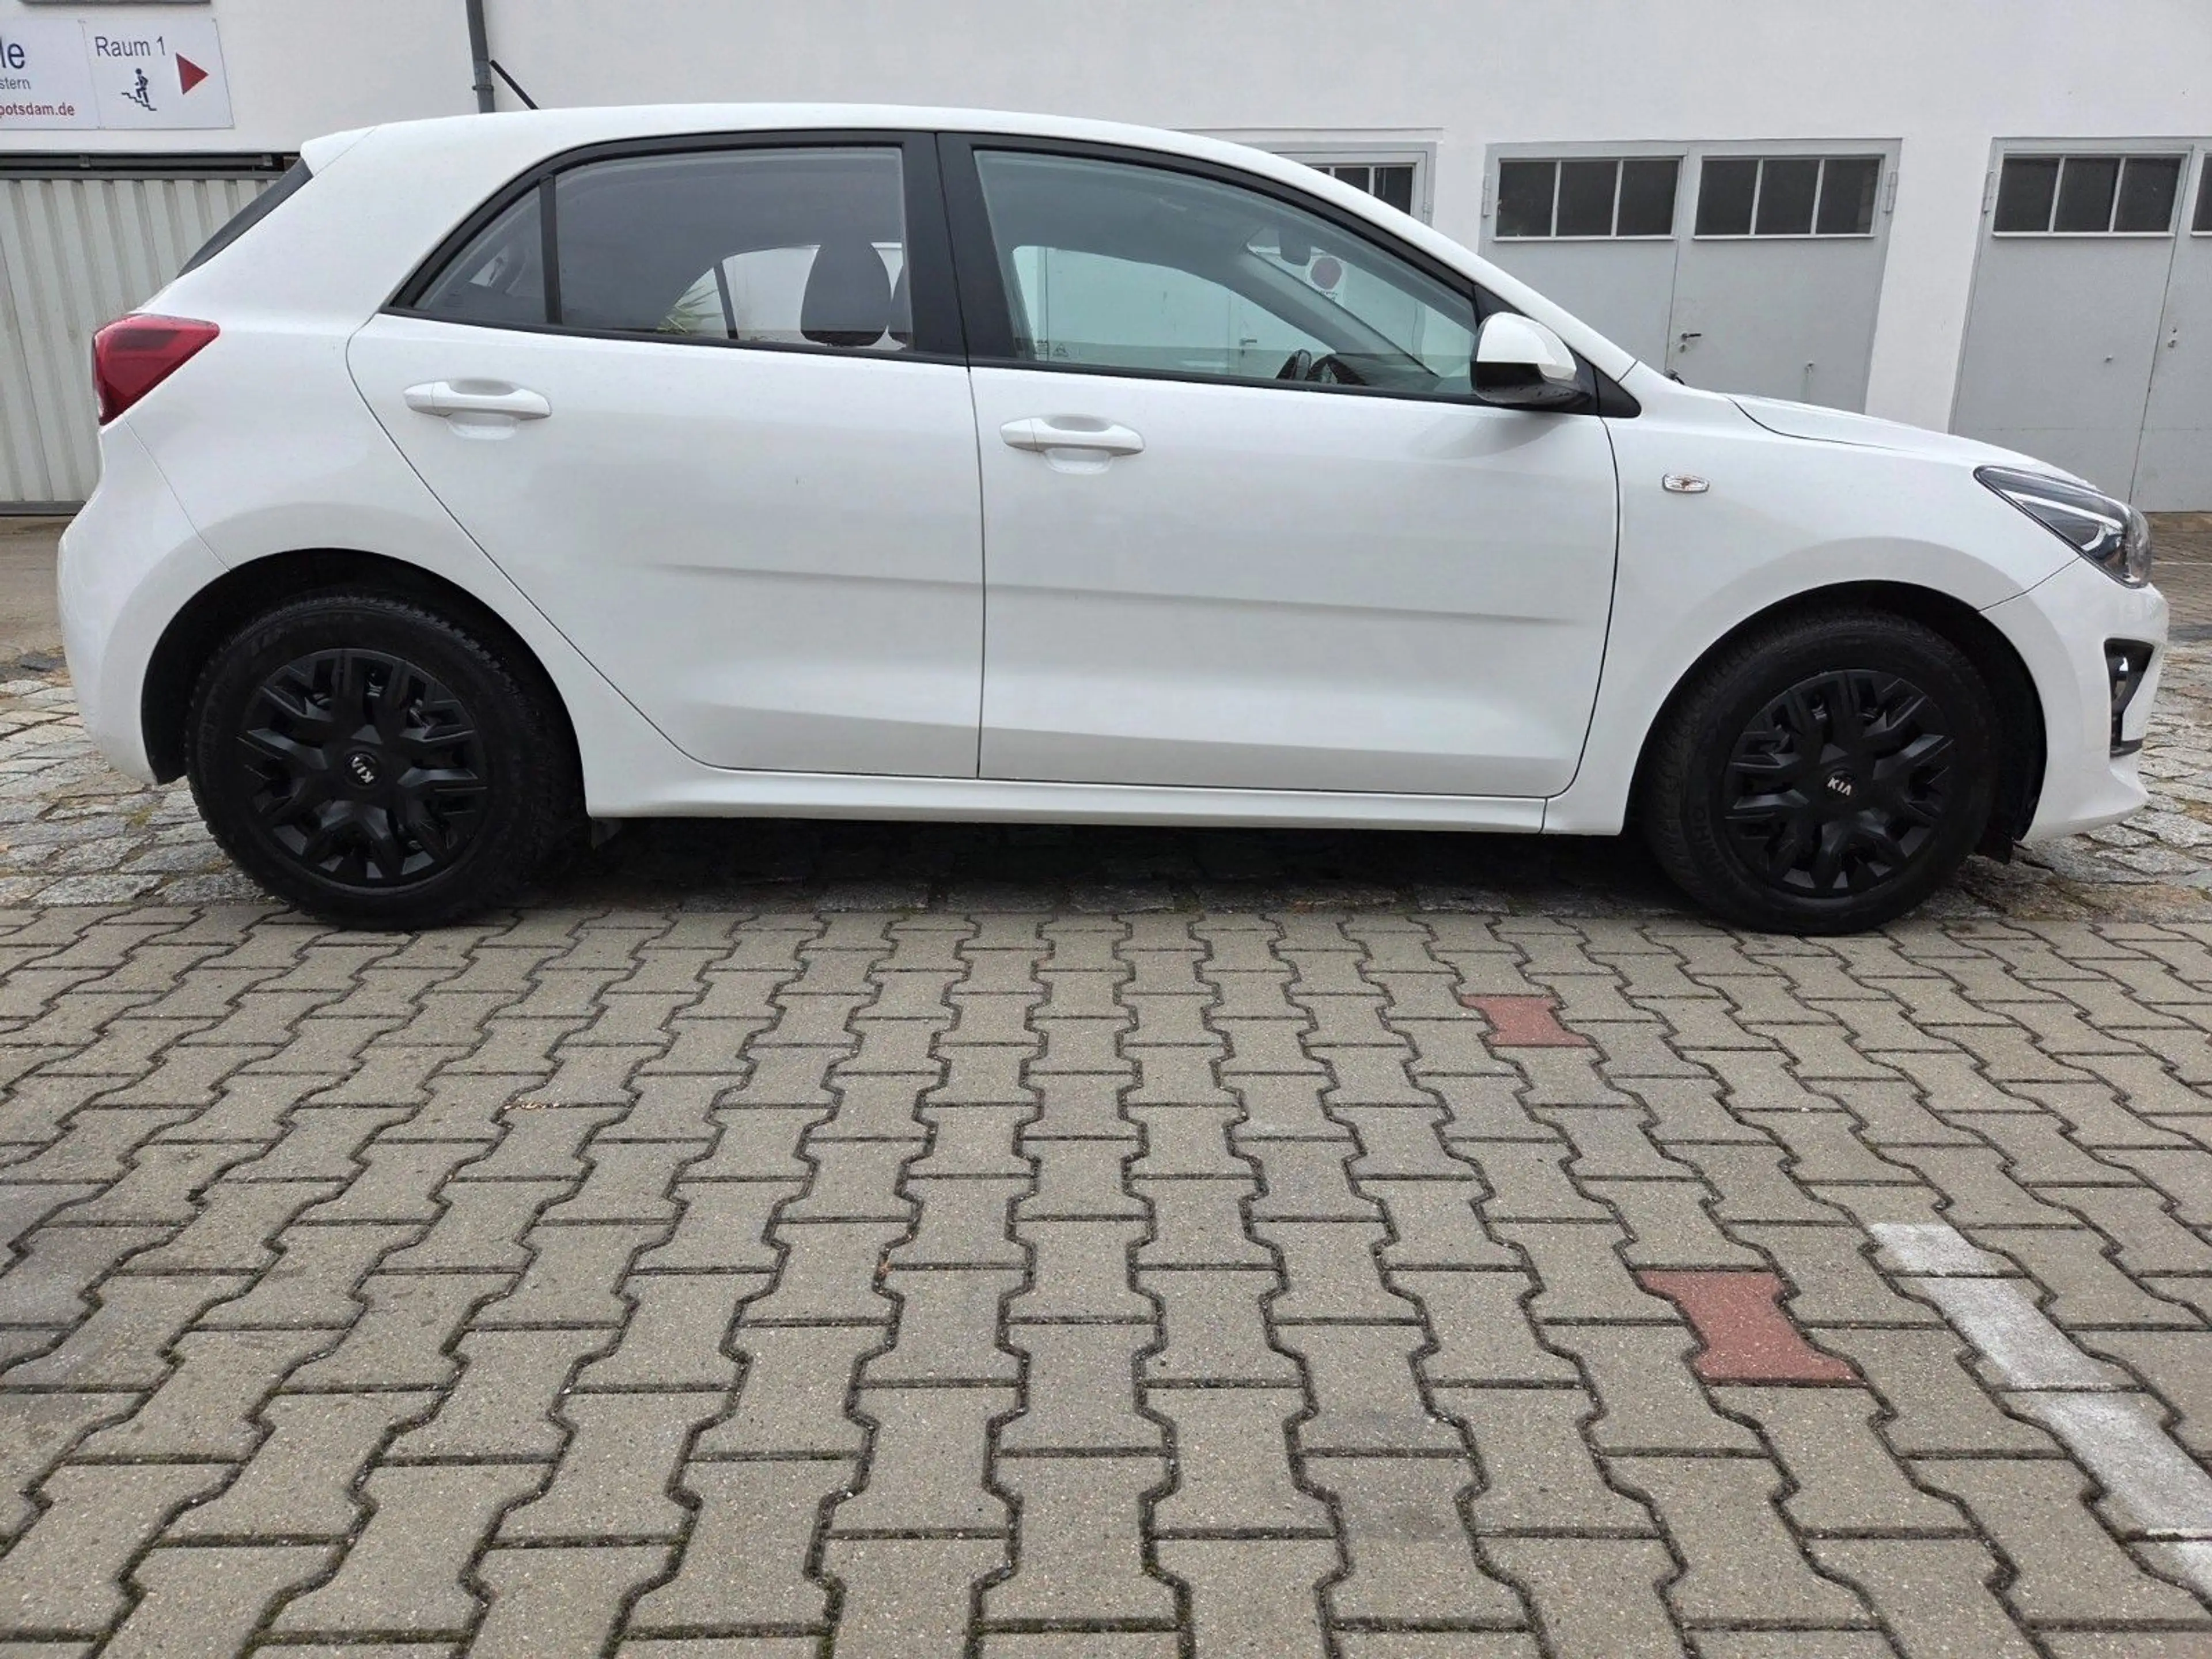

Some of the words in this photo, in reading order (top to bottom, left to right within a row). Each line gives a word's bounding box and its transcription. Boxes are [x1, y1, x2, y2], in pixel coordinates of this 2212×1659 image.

[94, 36, 151, 56] Raum
[156, 36, 165, 56] 1
[351, 756, 374, 783] KIA
[1827, 777, 1852, 796] KIA
